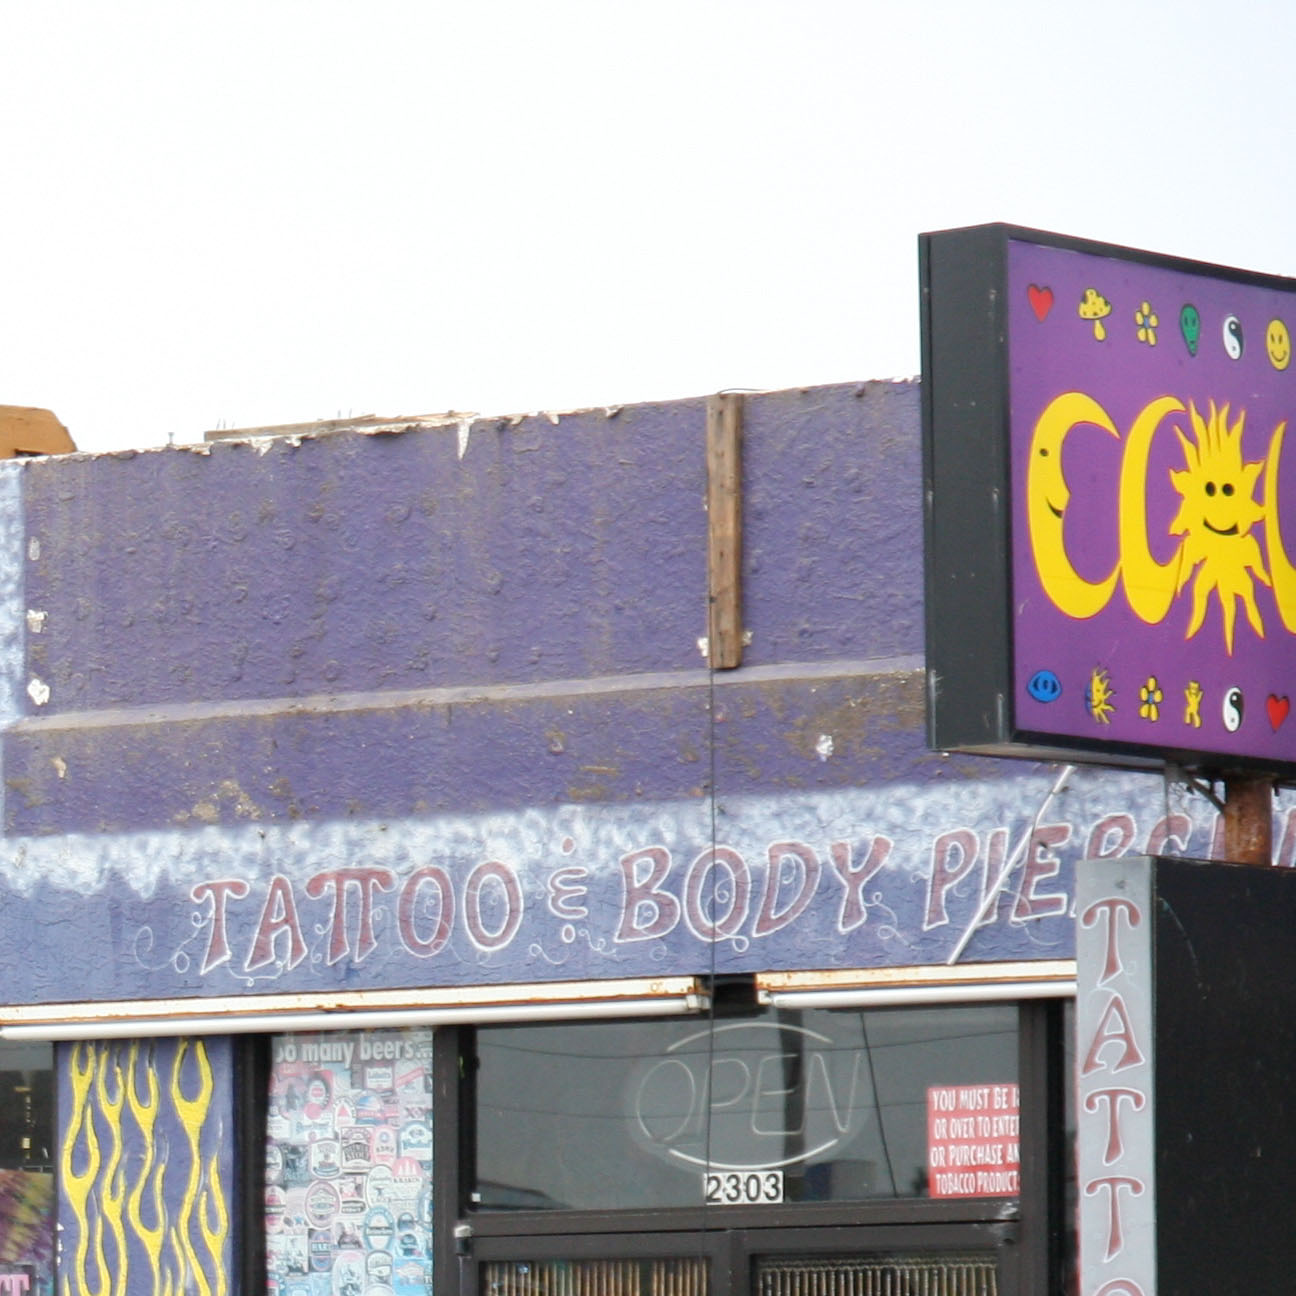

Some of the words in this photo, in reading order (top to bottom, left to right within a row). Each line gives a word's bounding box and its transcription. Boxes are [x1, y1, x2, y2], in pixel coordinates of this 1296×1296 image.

[191, 860, 525, 977] TATTOO
[614, 835, 894, 944] BODY
[302, 1042, 354, 1069] many
[636, 1053, 861, 1141] OPEN
[932, 1089, 956, 1111] YOU
[959, 1088, 990, 1110] MUST
[993, 1087, 1009, 1109] BE
[935, 1117, 948, 1139] OR
[950, 1116, 976, 1139] OVER
[977, 1116, 991, 1138] TO
[930, 1146, 946, 1168] OR
[948, 1144, 1003, 1167] PURCHASE
[706, 1173, 782, 1203] 2303
[935, 1172, 976, 1195] TOBACCO
[976, 1170, 1020, 1193] PRODUCT
